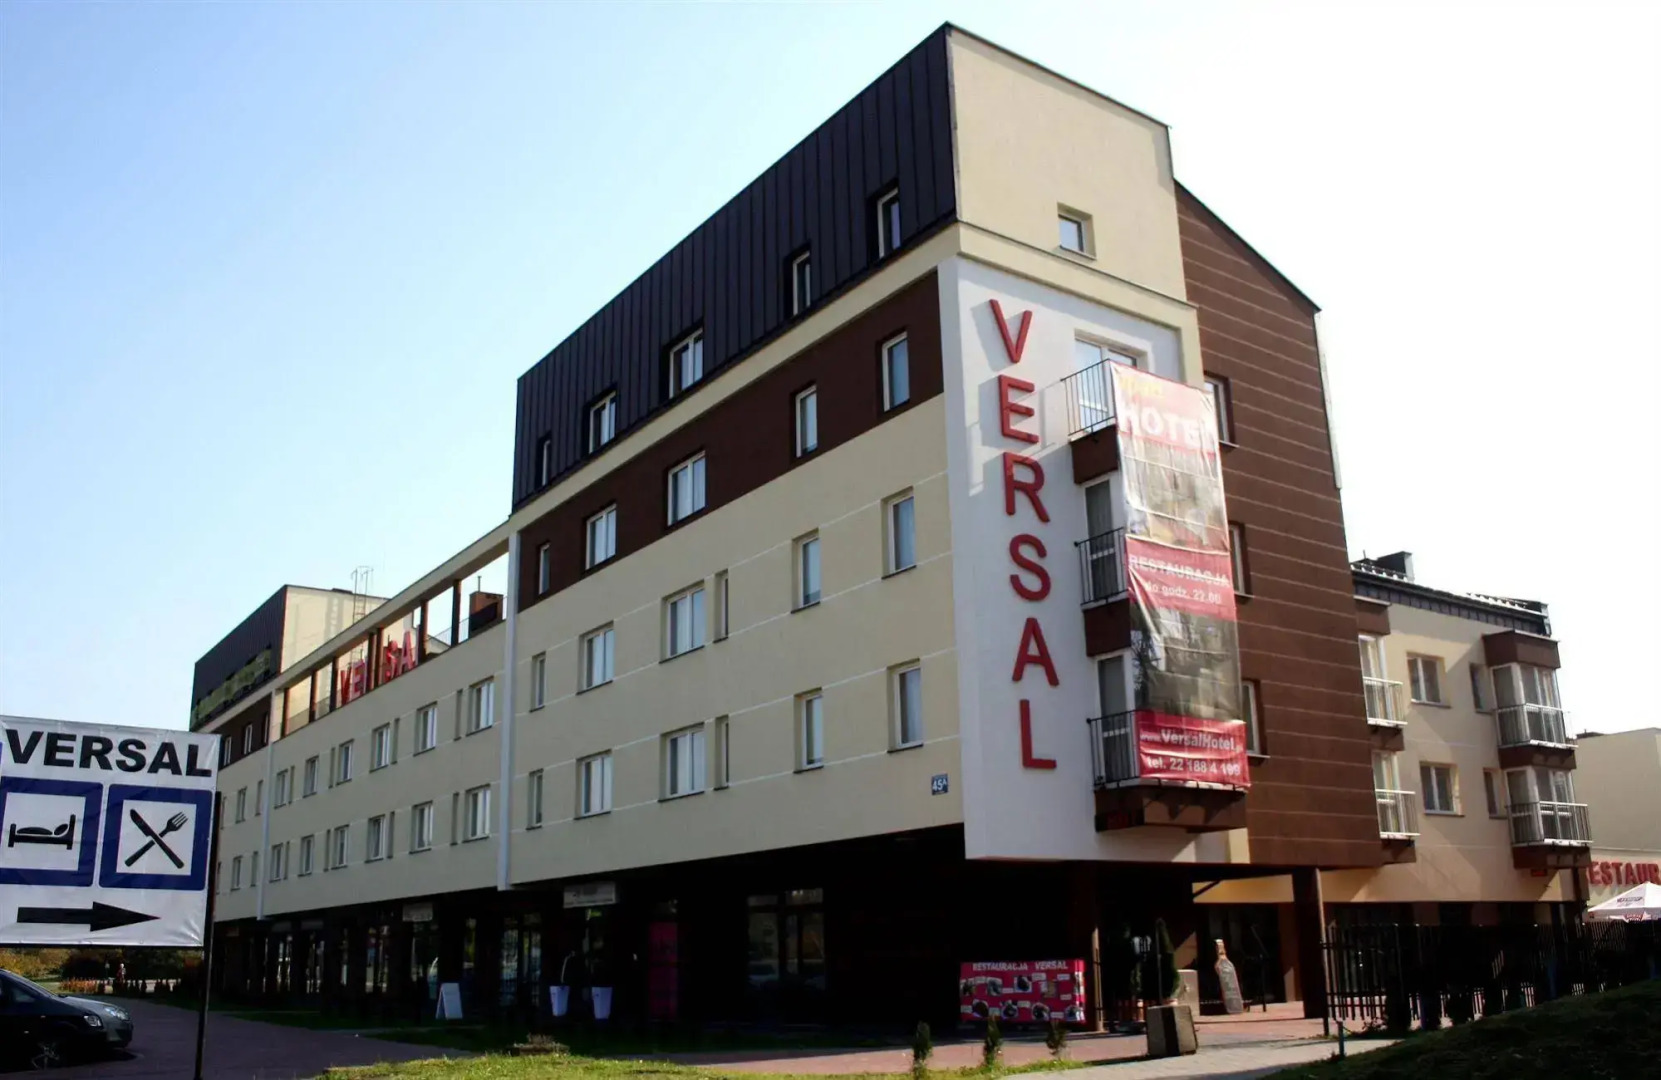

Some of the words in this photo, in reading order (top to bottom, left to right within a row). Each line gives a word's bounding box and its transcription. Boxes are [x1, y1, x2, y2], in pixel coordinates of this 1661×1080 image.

[989, 297, 1059, 770] VERSAL
[1128, 553, 1230, 587] RESTAURACJA
[5, 728, 213, 778] VERSAL
[1147, 755, 1166, 770] tel.
[1169, 757, 1184, 771] 22
[1187, 759, 1207, 773] 188
[1209, 762, 1218, 774] 4
[972, 961, 1028, 971] RESTAURACJA
[1034, 960, 1069, 970] VERSAL
